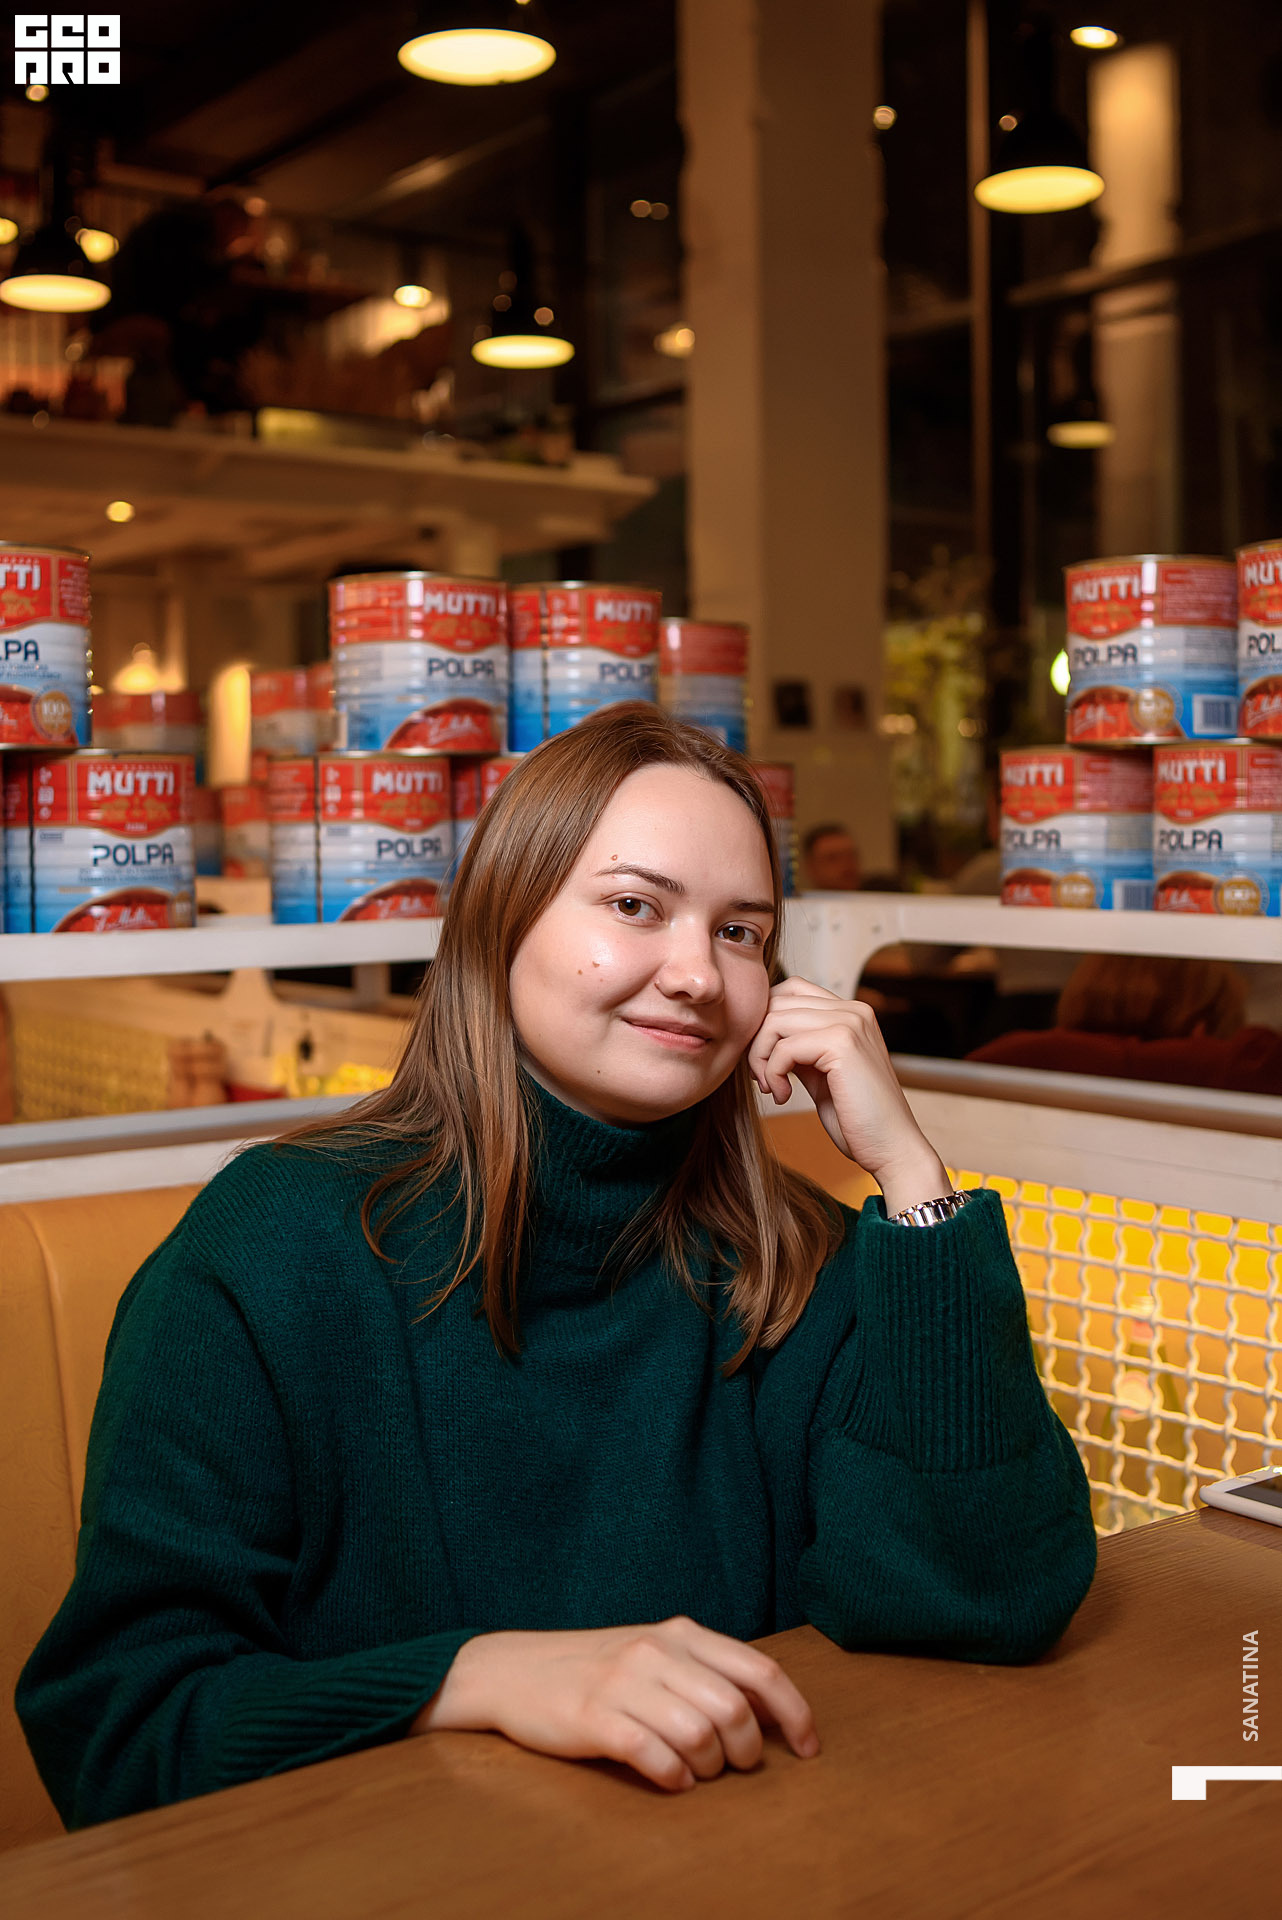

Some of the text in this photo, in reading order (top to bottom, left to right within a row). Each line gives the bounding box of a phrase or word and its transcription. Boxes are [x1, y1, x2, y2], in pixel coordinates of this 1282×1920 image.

[1072, 575, 1140, 604] MUTTI
[424, 592, 497, 616] MUTTI
[371, 771, 443, 794] MUTTI
[1158, 758, 1226, 784] MUTTI
[88, 770, 175, 797] MUTTI
[1160, 829, 1222, 850] POLPA
[91, 843, 174, 867] POLPA
